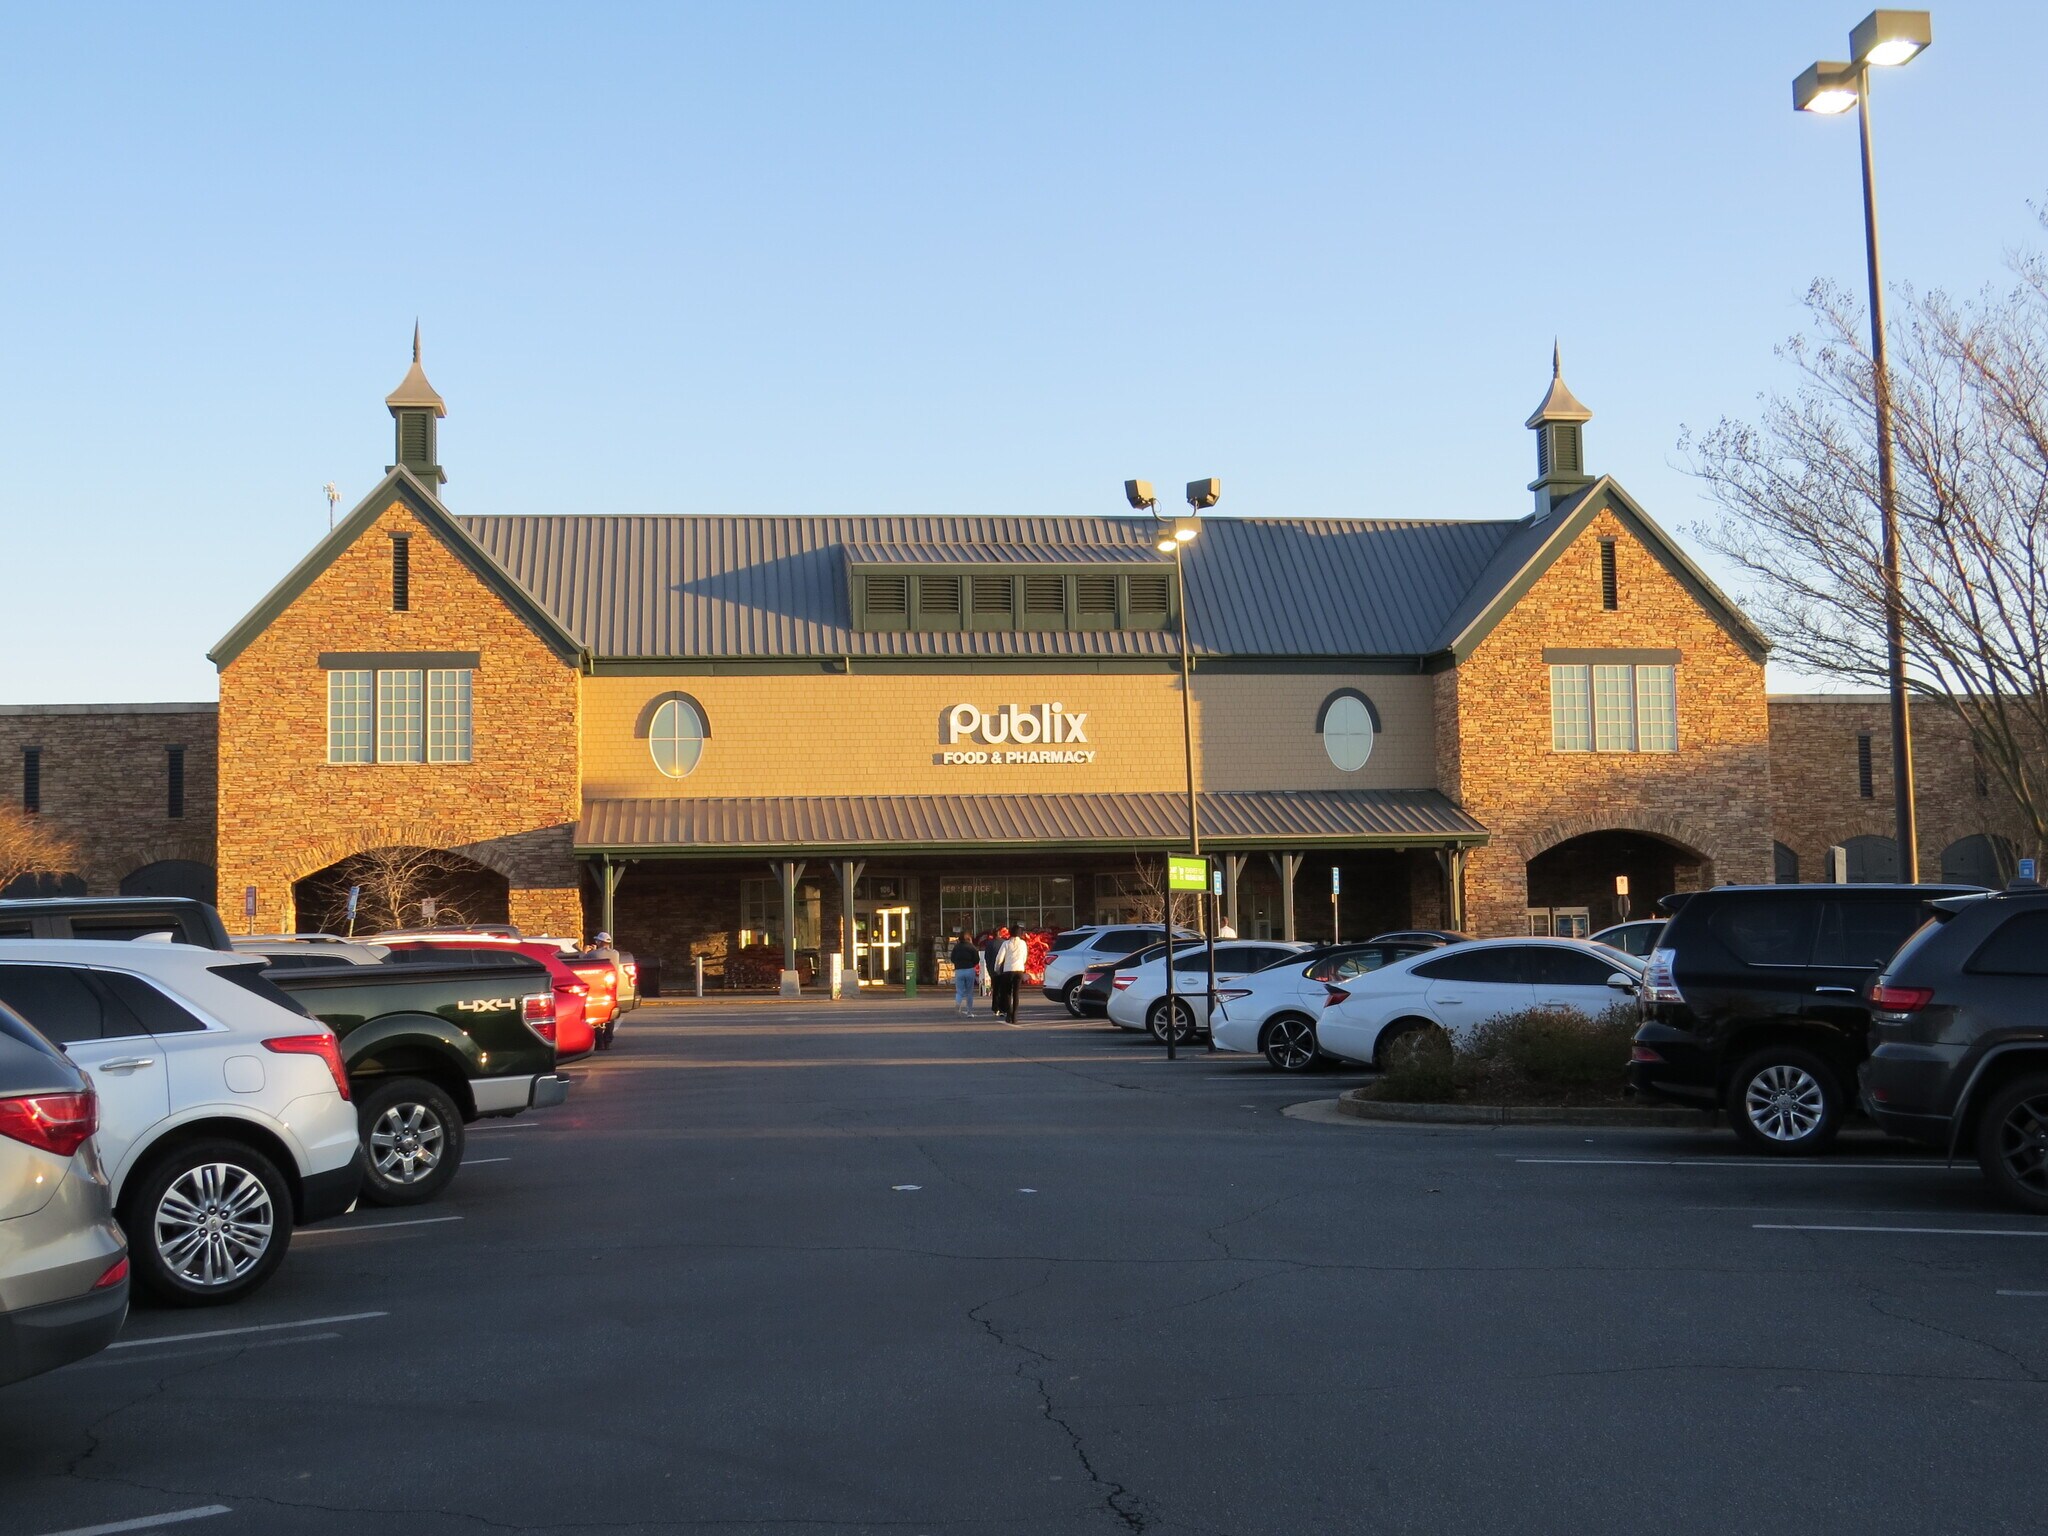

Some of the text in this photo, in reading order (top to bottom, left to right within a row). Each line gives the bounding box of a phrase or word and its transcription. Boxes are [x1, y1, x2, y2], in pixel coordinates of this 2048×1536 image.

[949, 702, 1088, 744] Publix
[943, 751, 1097, 764] FOOD & PHARMACY
[458, 998, 516, 1012] 4X4
